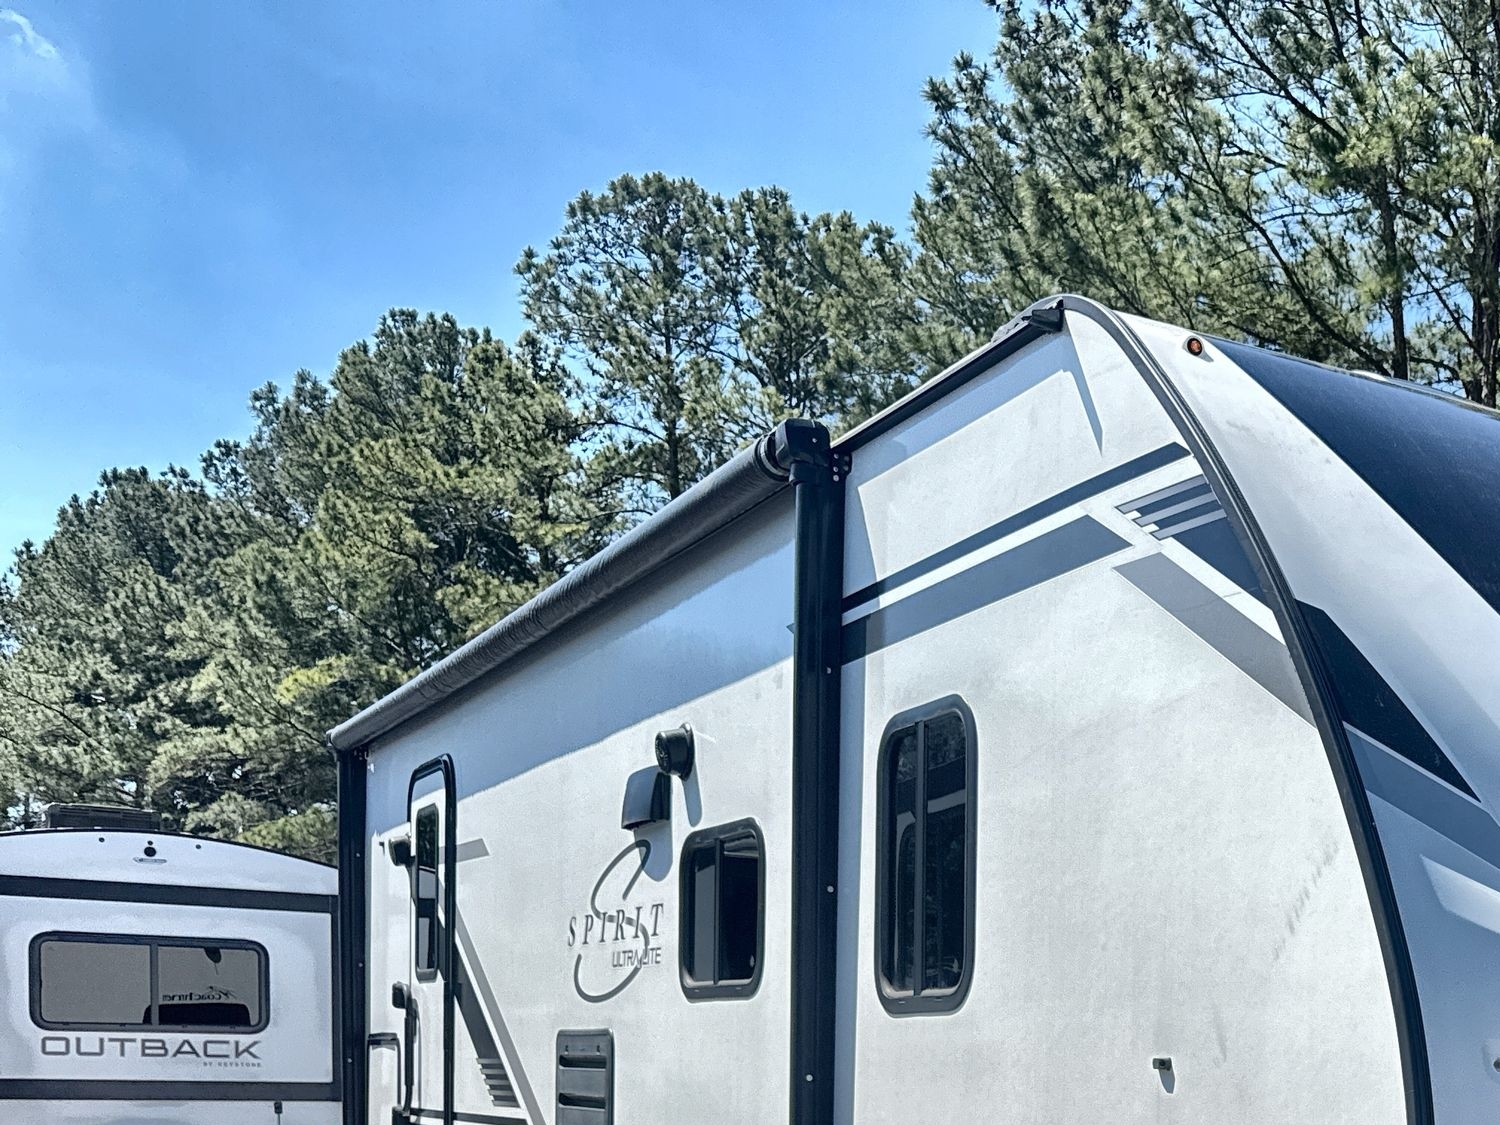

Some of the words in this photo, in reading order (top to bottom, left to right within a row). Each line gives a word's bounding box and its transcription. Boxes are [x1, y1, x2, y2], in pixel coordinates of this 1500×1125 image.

[568, 903, 664, 947] SPIRIT
[612, 949, 641, 968] ULTRA
[642, 947, 662, 966] LITE
[41, 1036, 262, 1060] OUTBACK
